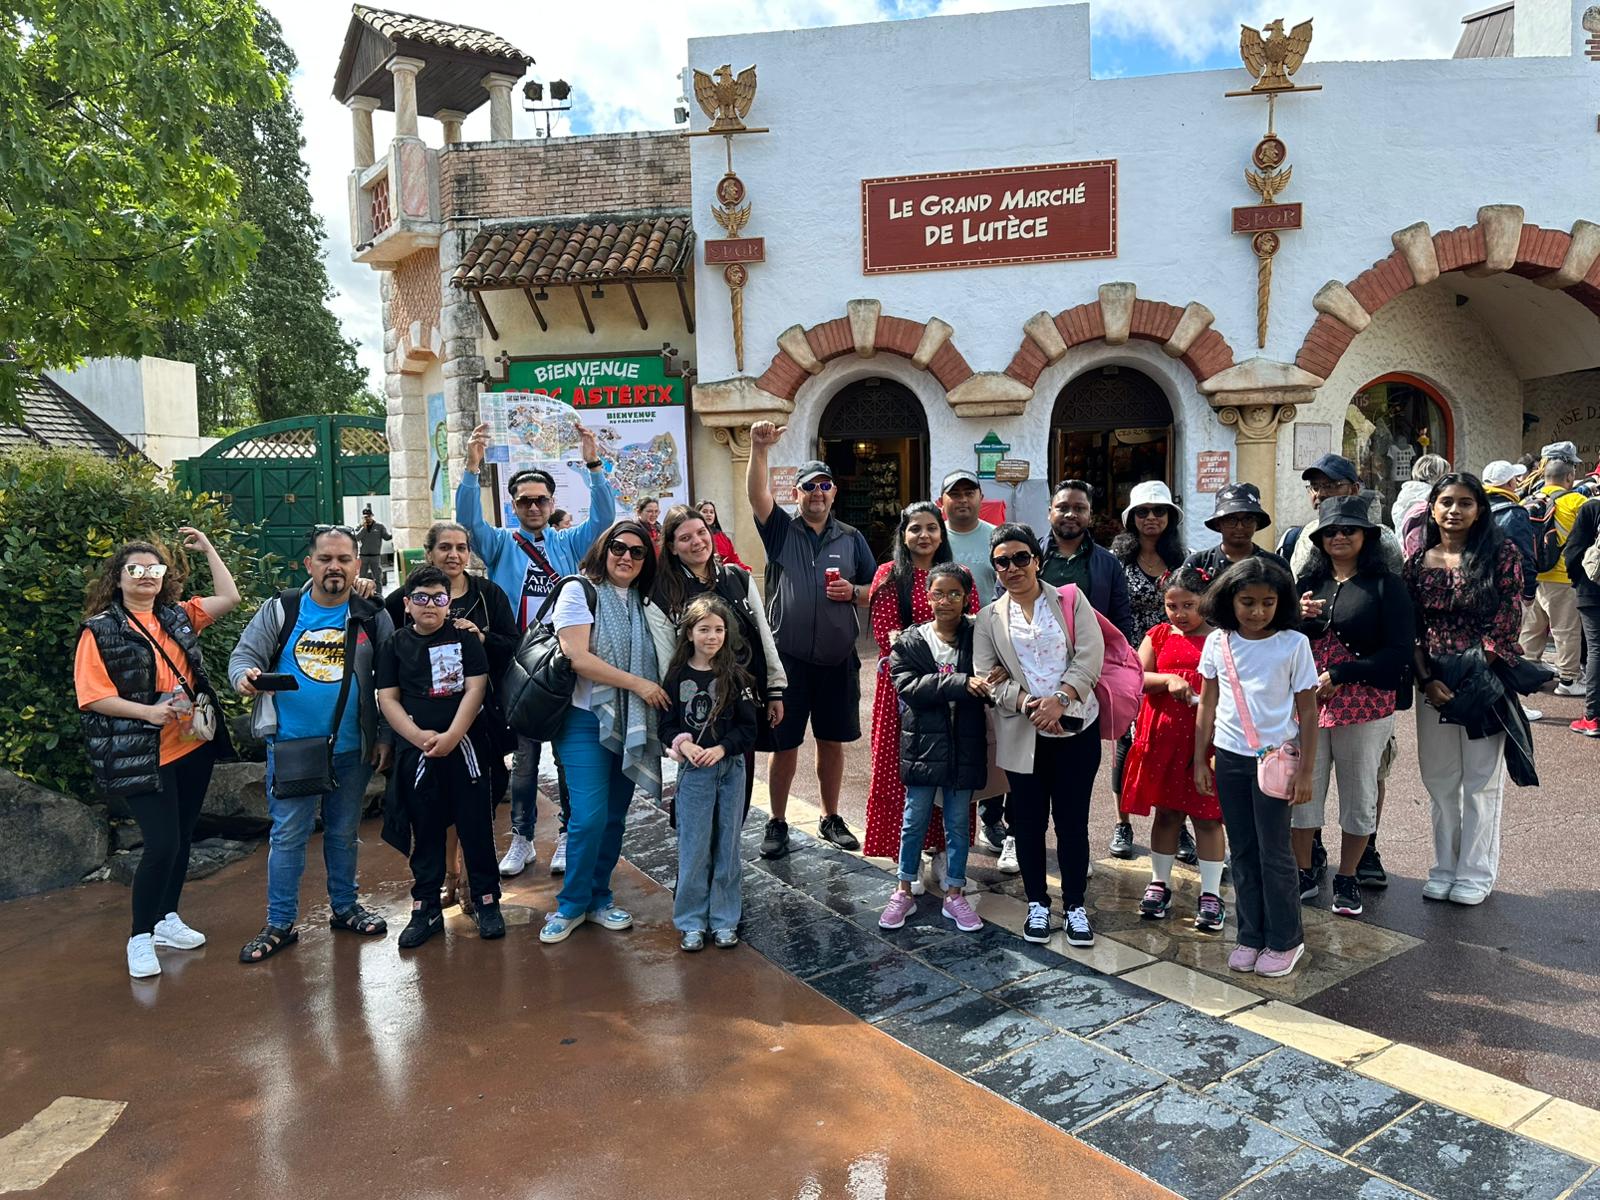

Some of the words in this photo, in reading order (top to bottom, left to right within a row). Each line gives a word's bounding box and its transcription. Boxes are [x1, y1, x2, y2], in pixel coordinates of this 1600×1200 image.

[889, 198, 913, 220] LE
[920, 194, 993, 216] GRAND
[999, 182, 1086, 211] MARCHÉ
[925, 224, 954, 246] DE
[962, 215, 1048, 244] LUTÈCE
[579, 376, 595, 386] AU
[606, 411, 656, 419] BIENVENUE
[527, 574, 555, 586] ATA
[527, 584, 553, 594] AIRW
[296, 645, 345, 657] SUMME
